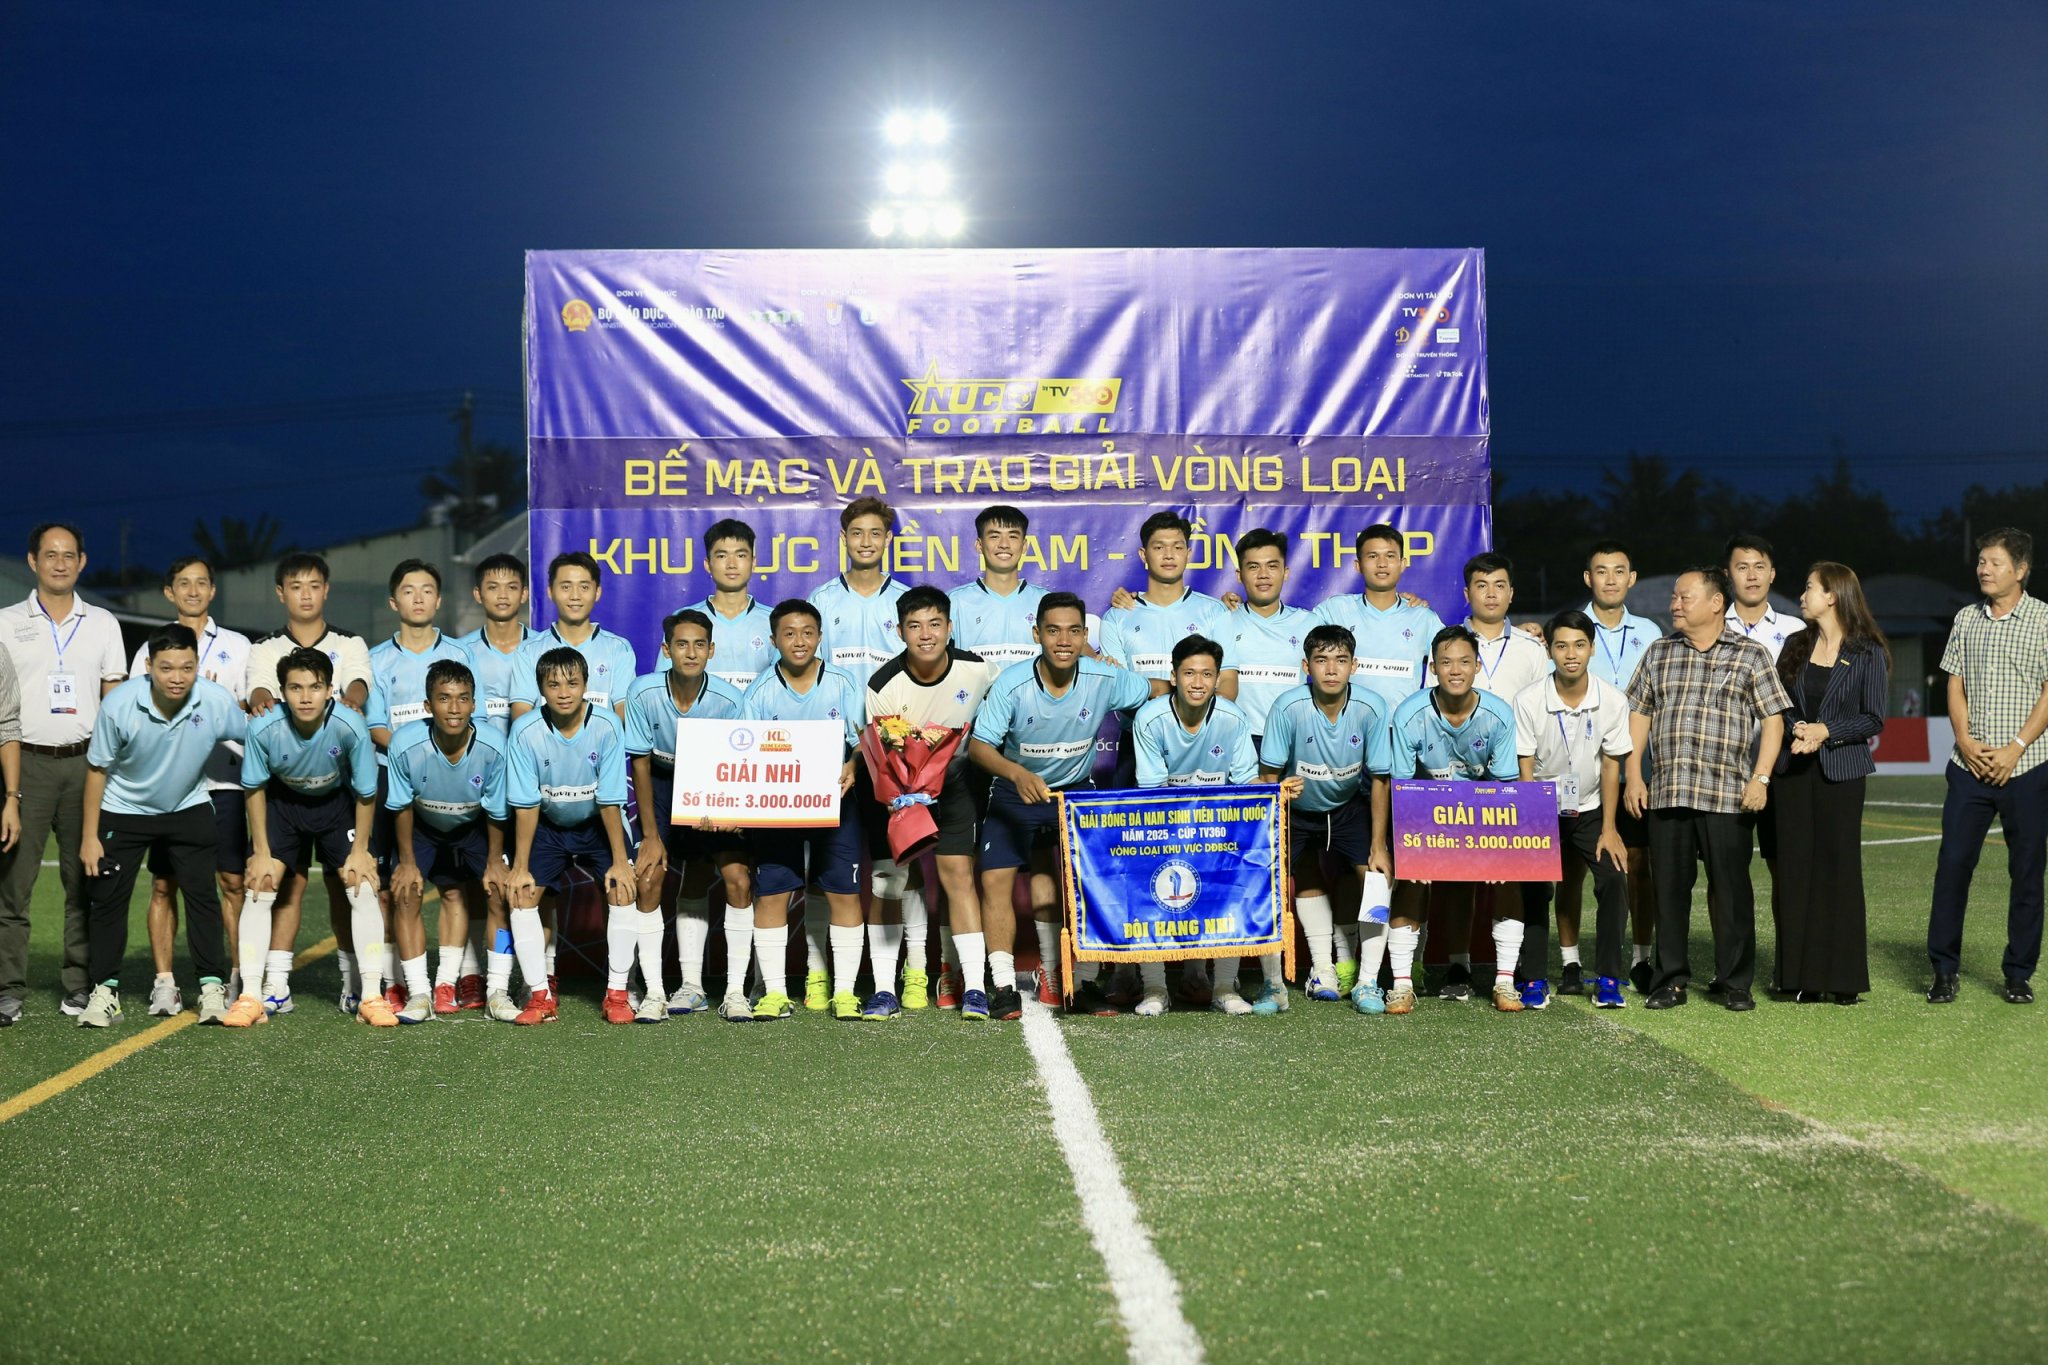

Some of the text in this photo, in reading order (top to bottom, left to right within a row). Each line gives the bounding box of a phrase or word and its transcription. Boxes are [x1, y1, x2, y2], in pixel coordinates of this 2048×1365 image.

[706, 307, 725, 322] TẠO
[907, 416, 1112, 434] FOOTBALL
[624, 440, 1406, 504] BẾ MẠC VÀ TRAO GIẢI VÒNG LOẠI
[589, 537, 693, 575] KHU
[753, 532, 820, 581] ỰC
[1300, 521, 1434, 569] THP
[716, 758, 801, 783] GIẢI NHÌ
[682, 790, 832, 808] Số tiền: 3.000.000đ
[1079, 801, 1267, 829] GIẢI BÓNG ĐÁ NAM SINH VIÊN TOÀN QUỐC
[1433, 801, 1518, 827] GIẢI NHÌ
[1121, 828, 1145, 842] NĂM
[1146, 829, 1169, 842] 2025
[1178, 825, 1197, 840] CÚP
[1199, 826, 1227, 839] TV360
[1403, 831, 1551, 850] Số tiền: 3.000.000đ
[1110, 844, 1137, 857] VÒNG
[1139, 845, 1160, 858] LOẠI
[1162, 844, 1181, 855] KHU
[1184, 842, 1203, 856] VỰC
[852, 863, 859, 883] 7
[1123, 918, 1149, 942] ĐỘI
[1204, 912, 1236, 935] NHÌ
